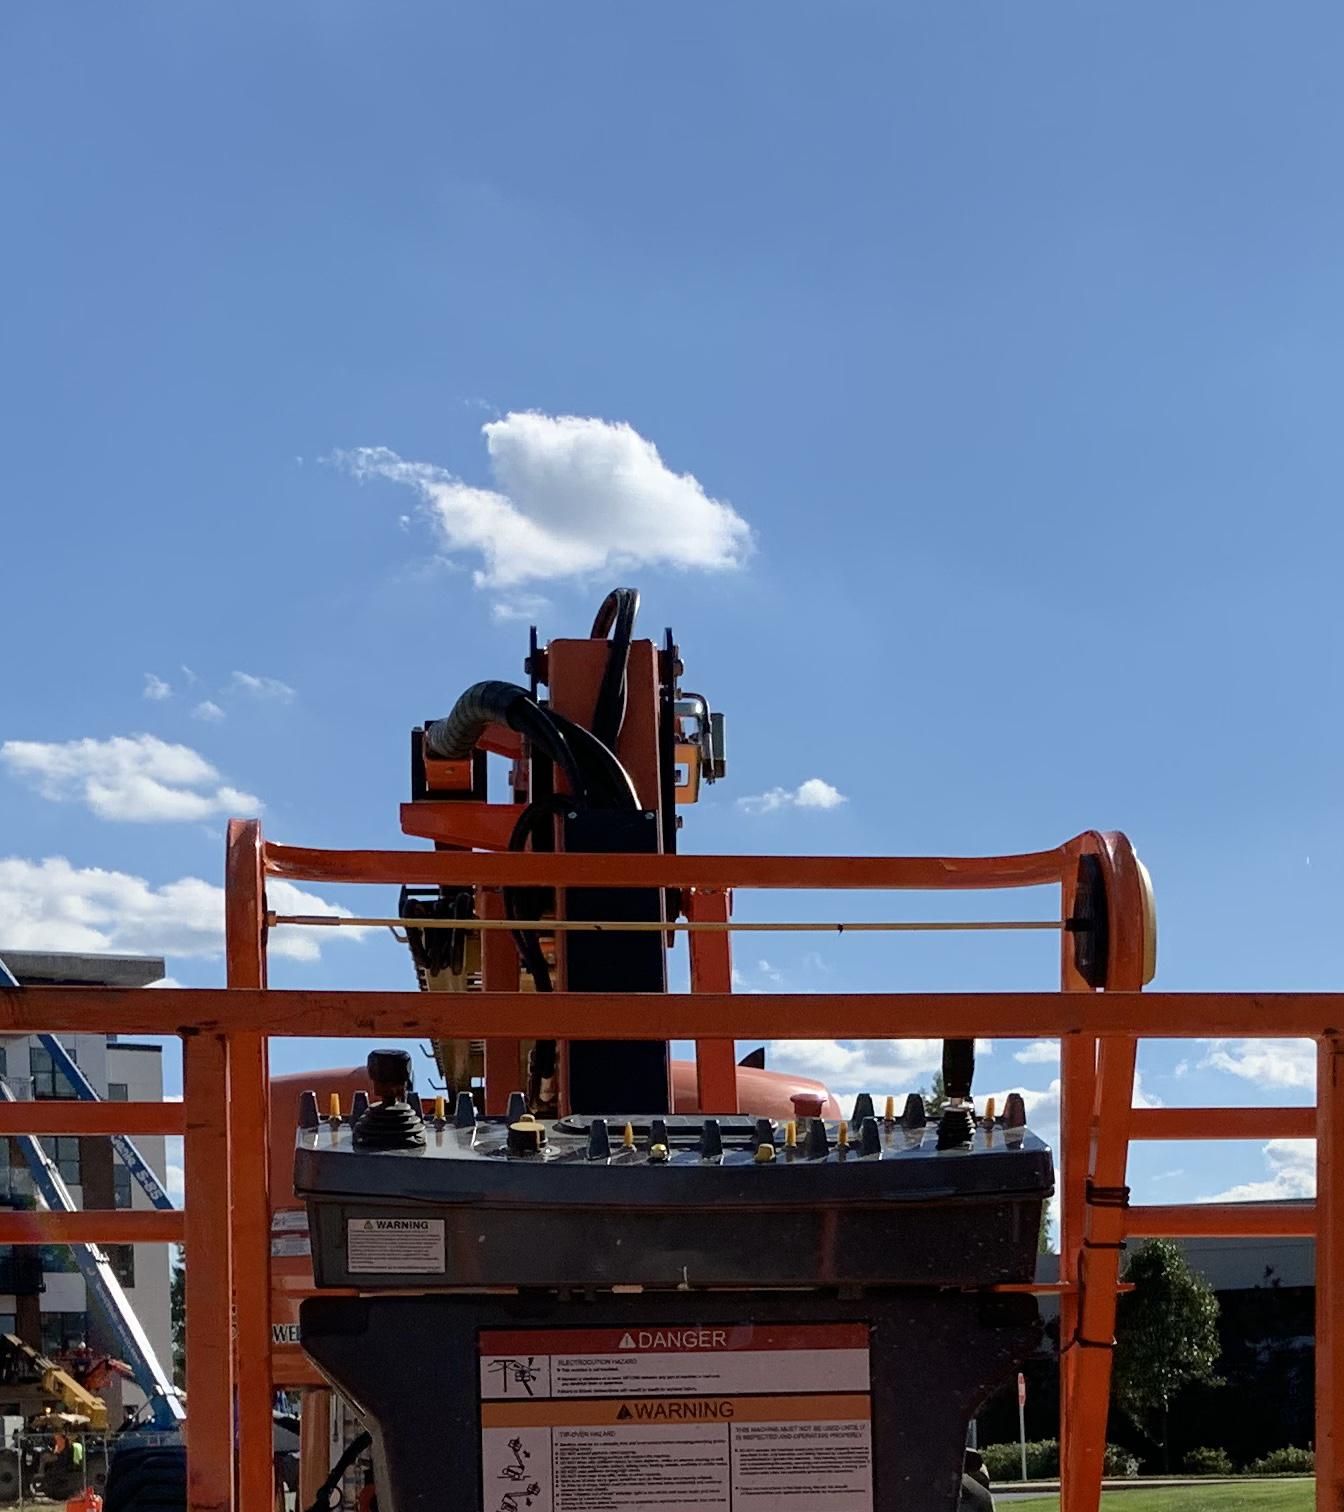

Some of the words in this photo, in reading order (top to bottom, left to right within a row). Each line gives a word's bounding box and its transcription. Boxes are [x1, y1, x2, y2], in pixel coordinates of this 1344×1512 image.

[136, 1169, 164, 1201] S-85
[376, 1220, 429, 1230] WARNING
[638, 1330, 727, 1349] DANGER
[633, 1401, 735, 1420] WARNING
